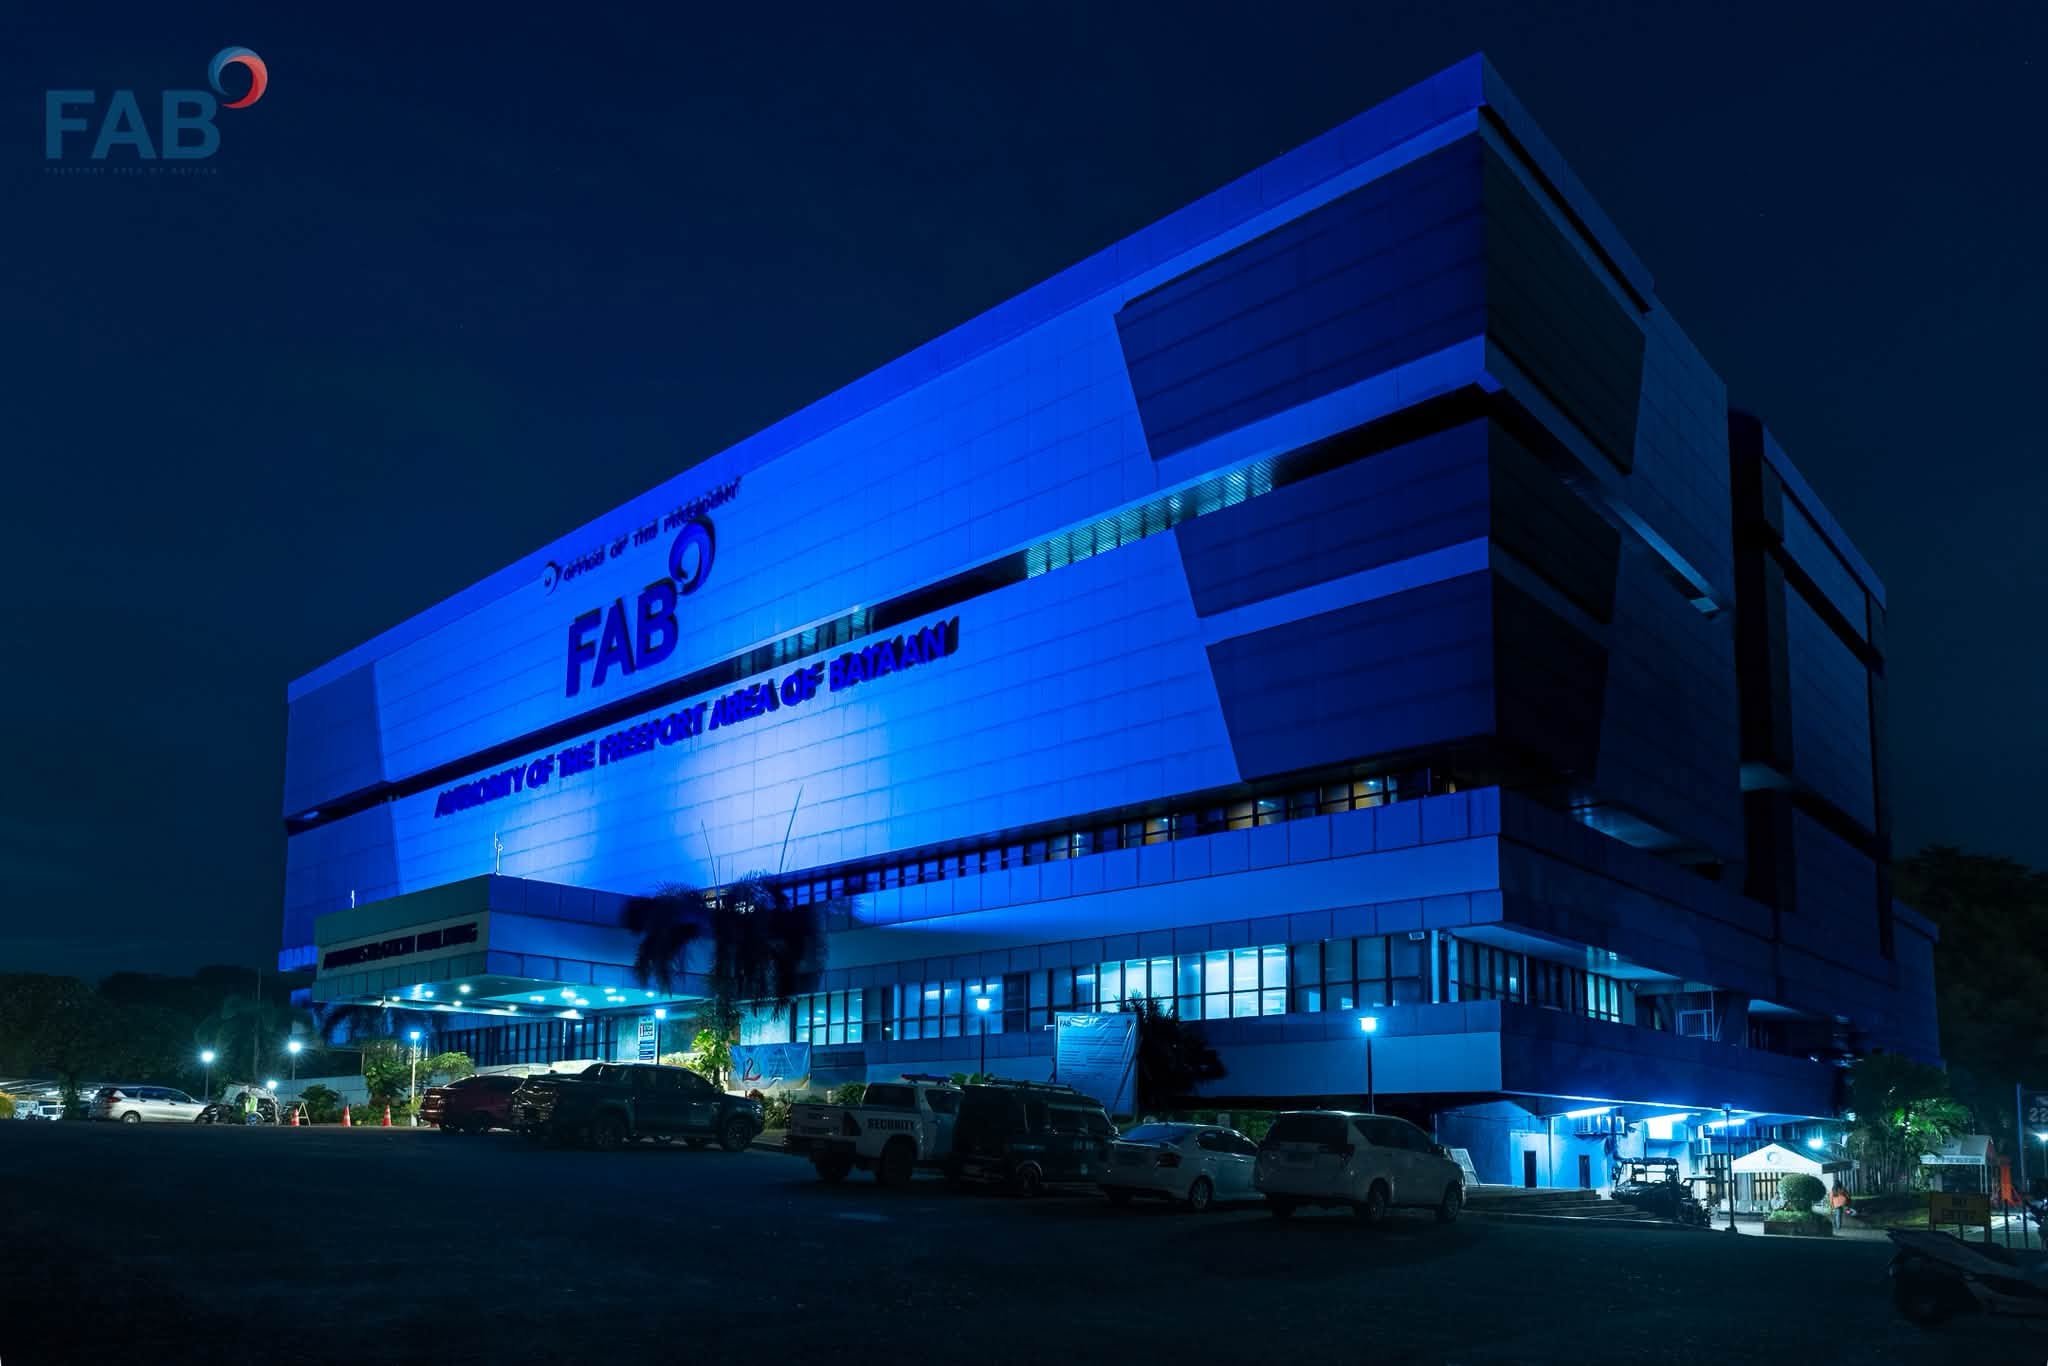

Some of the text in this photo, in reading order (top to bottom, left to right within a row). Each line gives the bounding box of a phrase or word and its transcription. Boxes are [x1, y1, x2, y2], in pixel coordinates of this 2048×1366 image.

[610, 533, 629, 559] OF
[632, 517, 659, 548] THE
[565, 578, 678, 697] FAB
[526, 754, 556, 789] OF
[558, 739, 596, 778] THE
[599, 701, 707, 766] FREEPORT
[708, 678, 780, 730] AREA
[780, 660, 825, 707] OF
[829, 616, 959, 692] BATAAN
[867, 1119, 914, 1129] SECURITY
